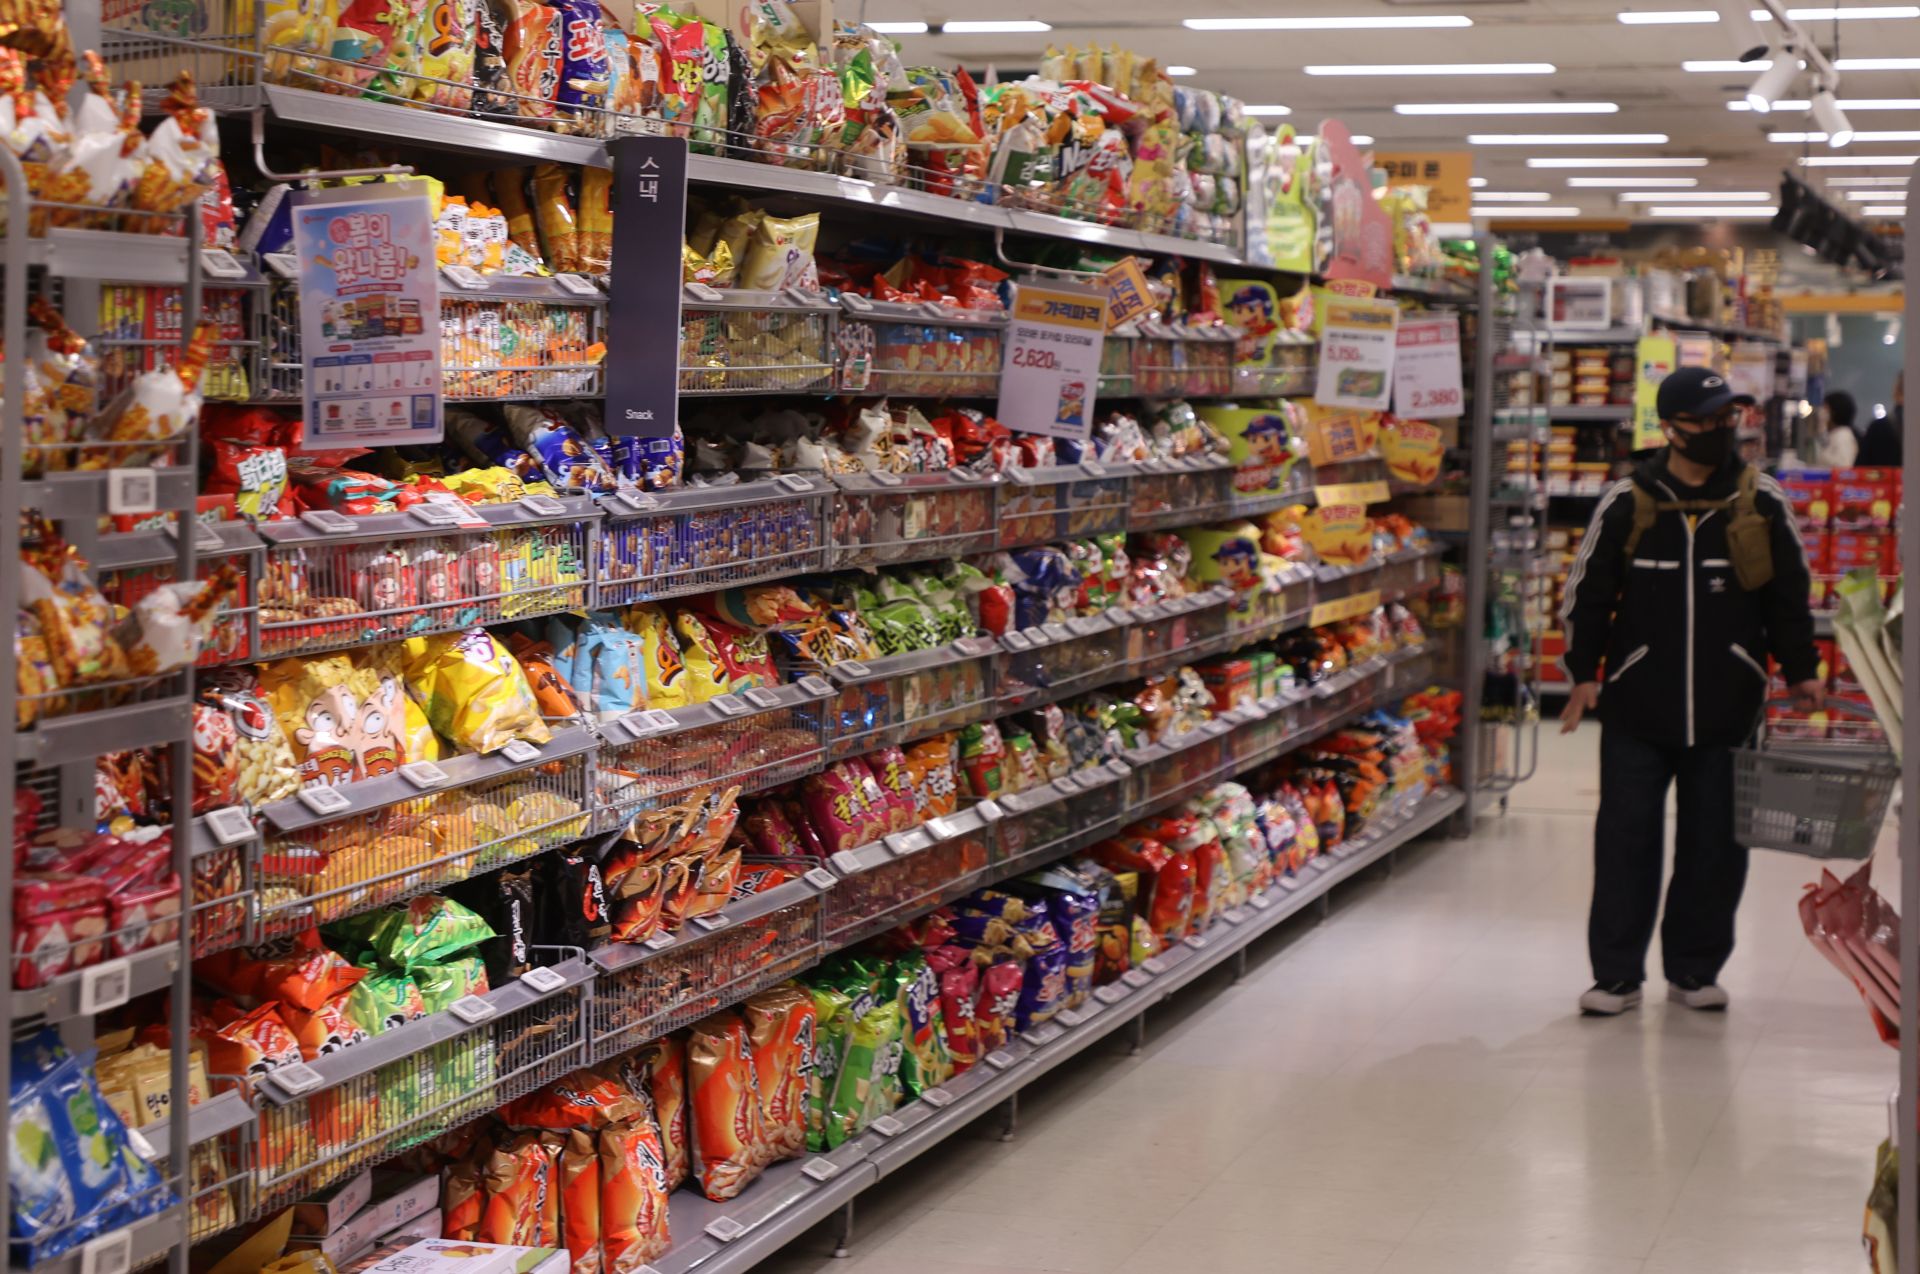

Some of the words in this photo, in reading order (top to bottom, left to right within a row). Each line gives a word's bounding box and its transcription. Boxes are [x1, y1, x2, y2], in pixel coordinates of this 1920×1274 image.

[640, 156, 660, 203] 스낵
[350, 213, 390, 248] 봄이
[334, 243, 407, 285] 왔나봄!
[1044, 301, 1099, 322] 가격파격
[626, 409, 654, 420] Snack
